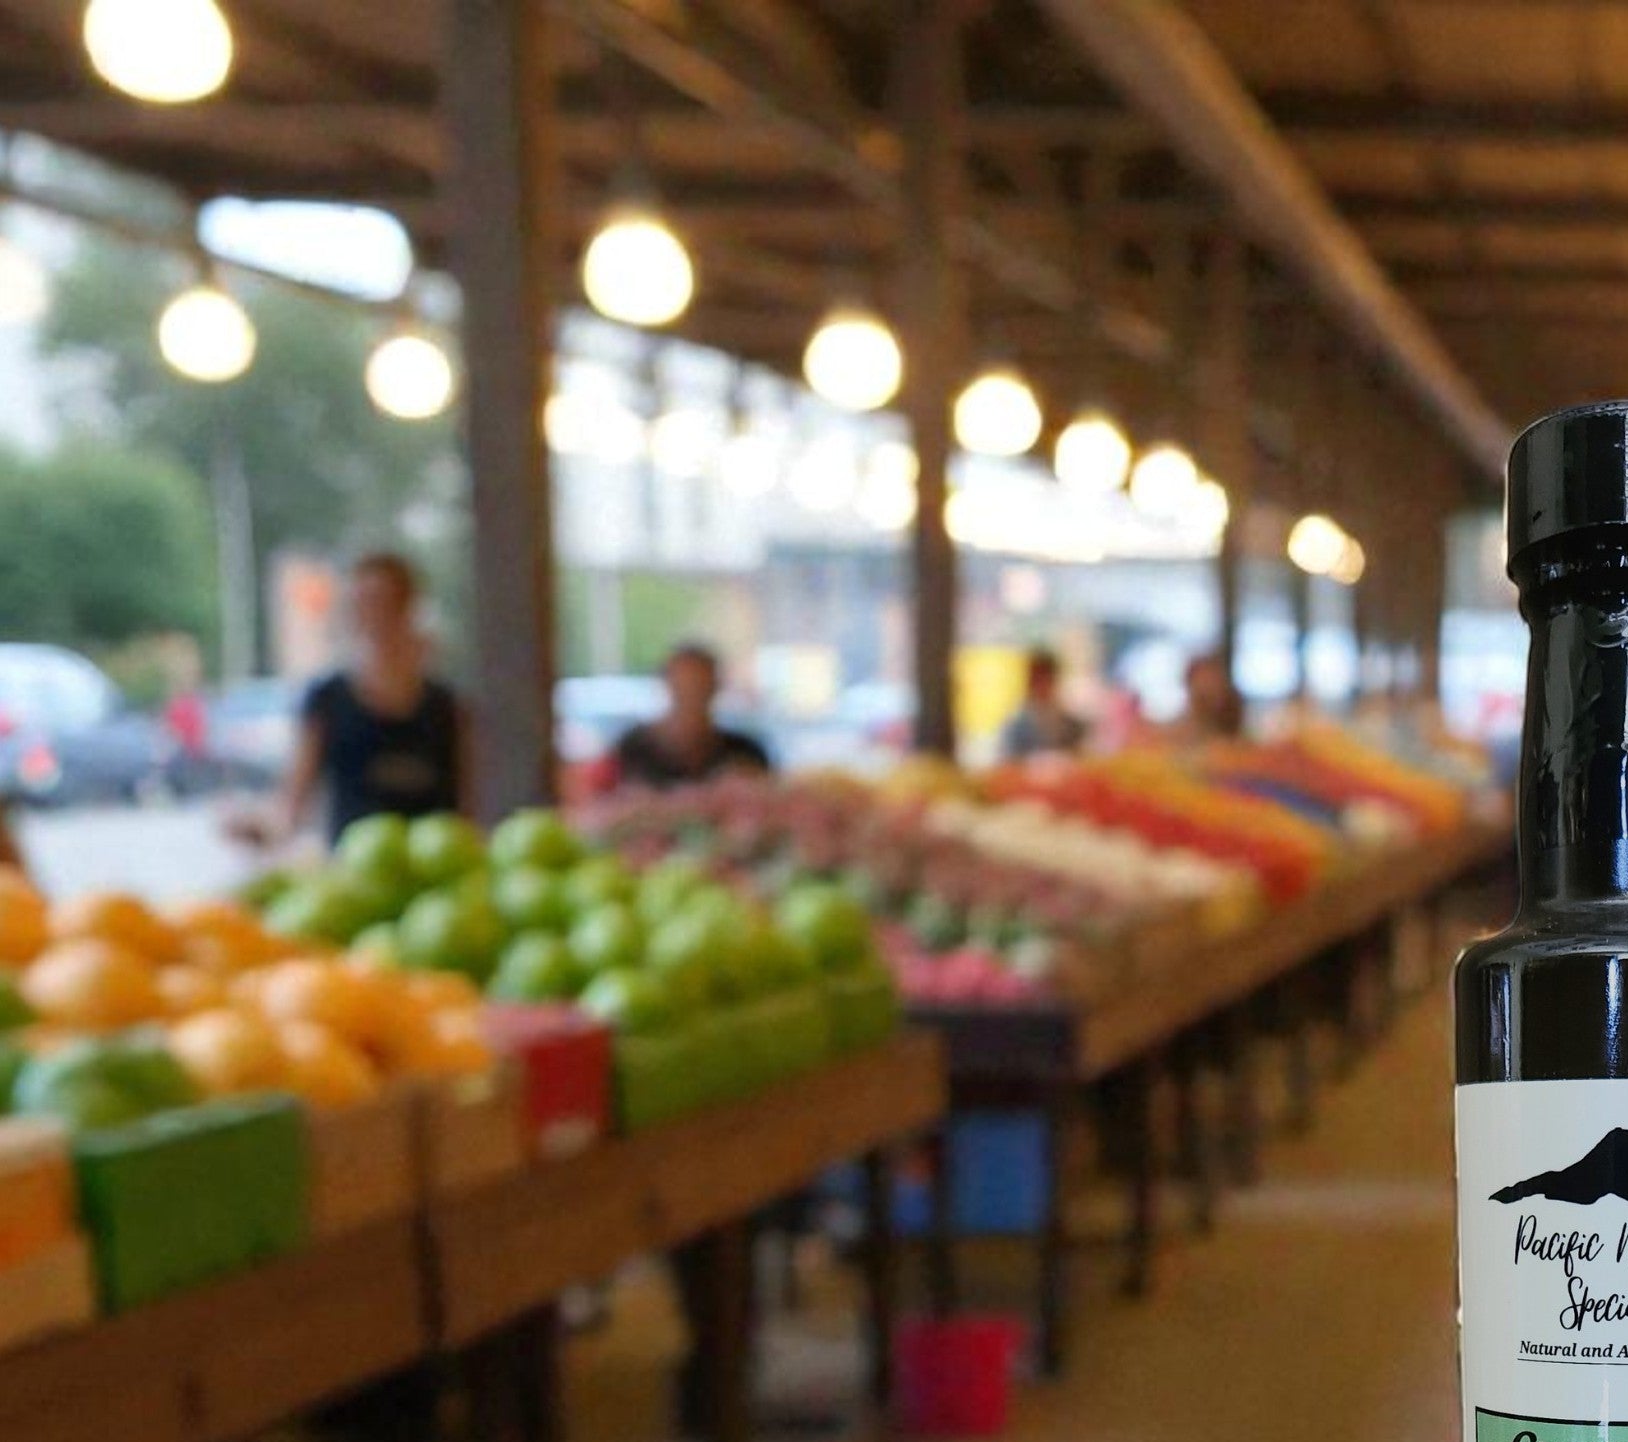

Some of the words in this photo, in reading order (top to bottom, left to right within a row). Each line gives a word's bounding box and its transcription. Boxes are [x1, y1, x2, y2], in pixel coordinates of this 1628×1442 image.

[1514, 1214, 1604, 1277] Pacific
[1519, 1340, 1577, 1359] Natural
[1580, 1342, 1613, 1359] and
